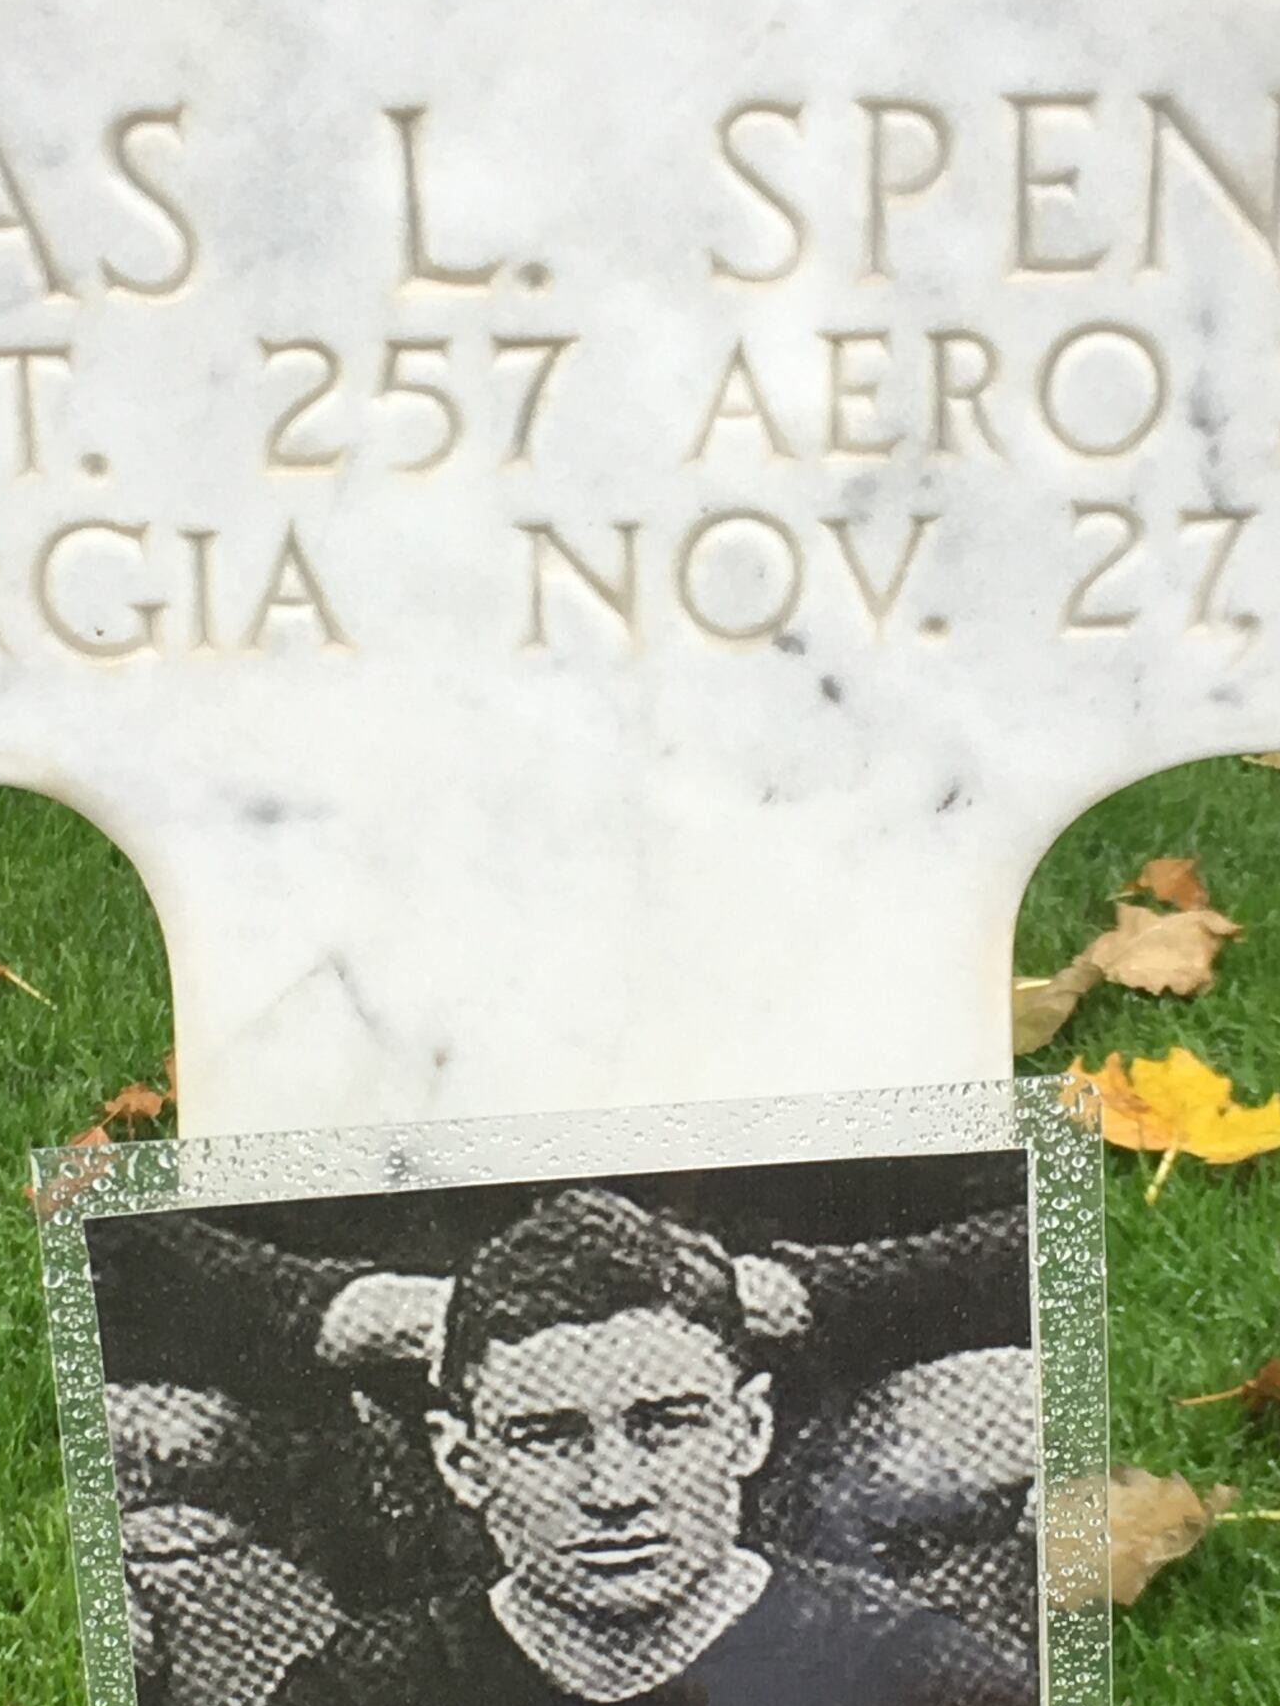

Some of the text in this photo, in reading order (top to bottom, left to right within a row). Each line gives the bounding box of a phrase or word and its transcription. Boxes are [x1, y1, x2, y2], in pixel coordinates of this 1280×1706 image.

[382, 103, 556, 293] L.
[254, 333, 582, 477] 257
[682, 317, 1170, 465] AERO
[510, 505, 952, 649] NOV.
